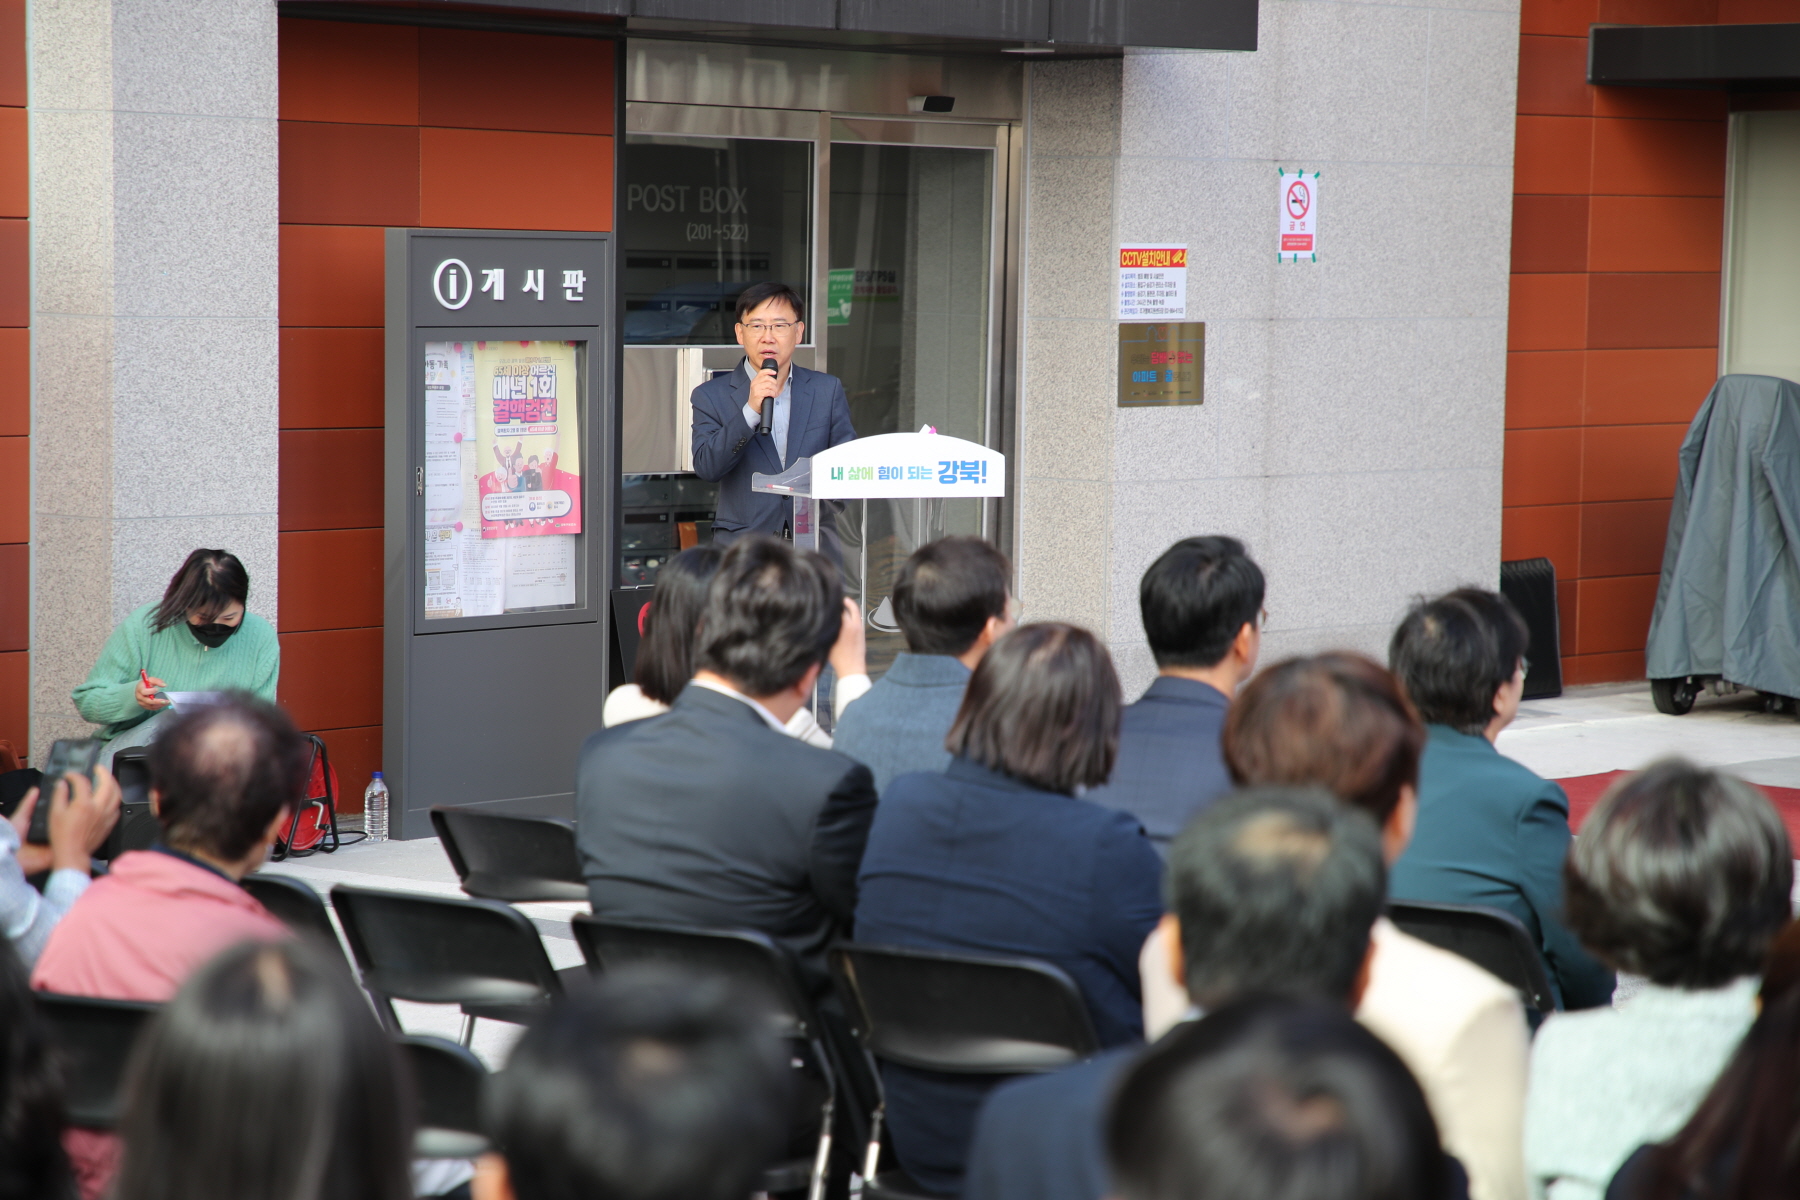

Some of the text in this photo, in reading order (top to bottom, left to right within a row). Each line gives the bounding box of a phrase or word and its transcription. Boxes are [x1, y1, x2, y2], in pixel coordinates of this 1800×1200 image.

[627, 183, 748, 214] POST BOX
[686, 222, 749, 242] (201~522)
[1121, 250, 1171, 267] CCTV설치안내
[1151, 350, 1168, 365] 담배
[493, 364, 557, 376] 65세 이상 어르신
[493, 375, 527, 400] 매년
[529, 375, 557, 399] 1회
[492, 398, 558, 424] 결핵검진
[831, 460, 987, 484] 내 삶에 힘이 되는 강북!
